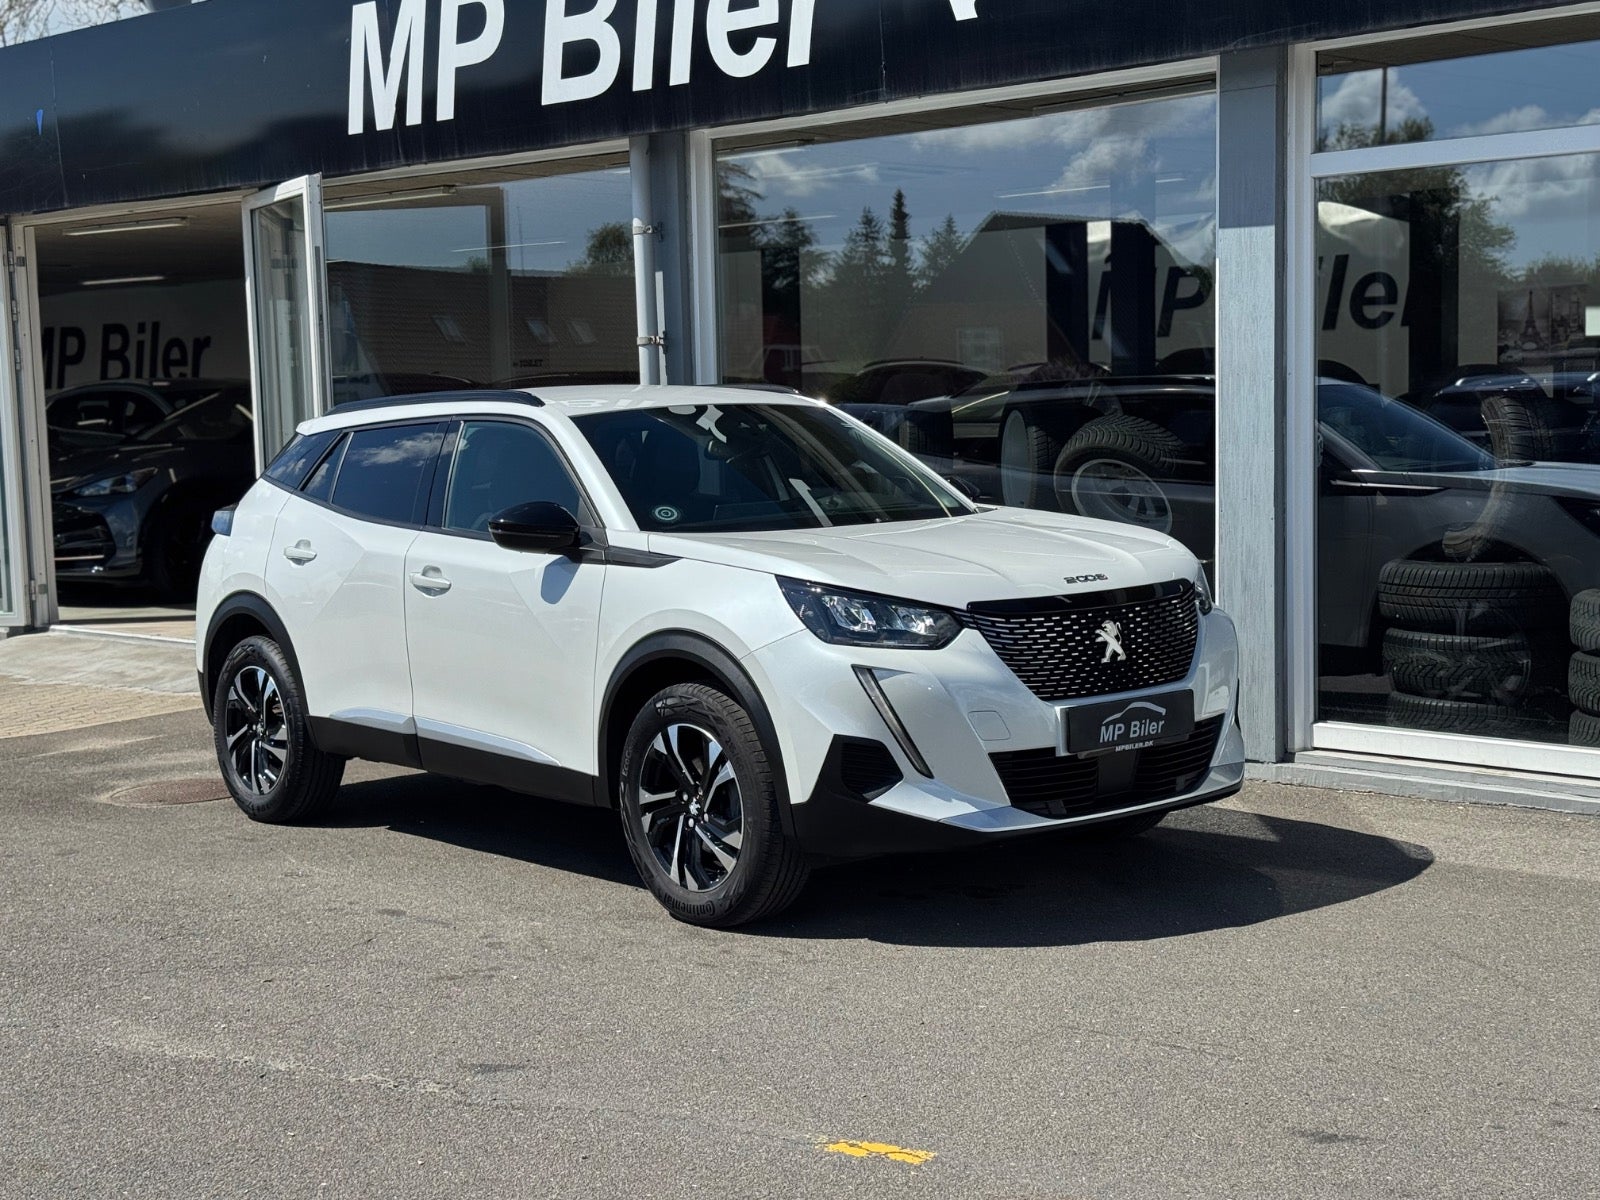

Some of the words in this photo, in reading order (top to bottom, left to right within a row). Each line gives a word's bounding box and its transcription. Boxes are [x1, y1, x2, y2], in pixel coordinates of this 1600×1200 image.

[348, 0, 505, 135] MP
[100, 321, 212, 380] Biler
[1100, 723, 1125, 743] MP
[1129, 719, 1165, 738] Biler
[1115, 740, 1153, 752] MPBILER.DK
[663, 892, 716, 917] Continental
